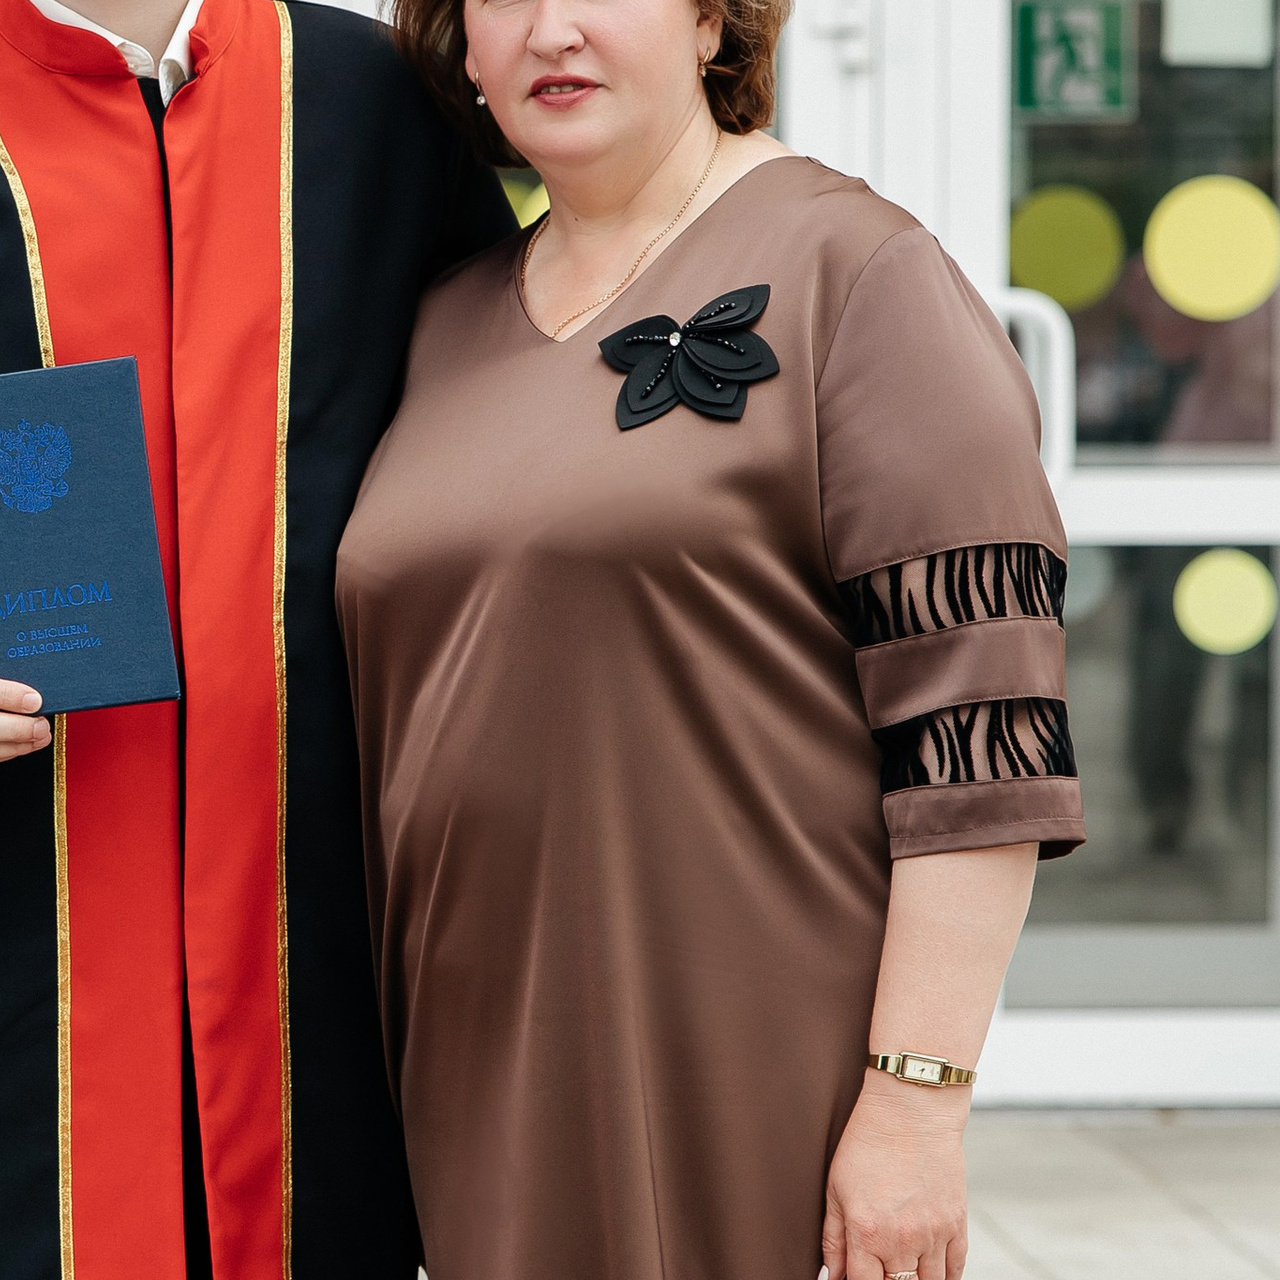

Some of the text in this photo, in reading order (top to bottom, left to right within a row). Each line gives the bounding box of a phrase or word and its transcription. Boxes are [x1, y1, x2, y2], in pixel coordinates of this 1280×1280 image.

[16, 624, 89, 642] О ВЫСШЕМ
[6, 636, 102, 658] ОБРАЗОВАНИИ
